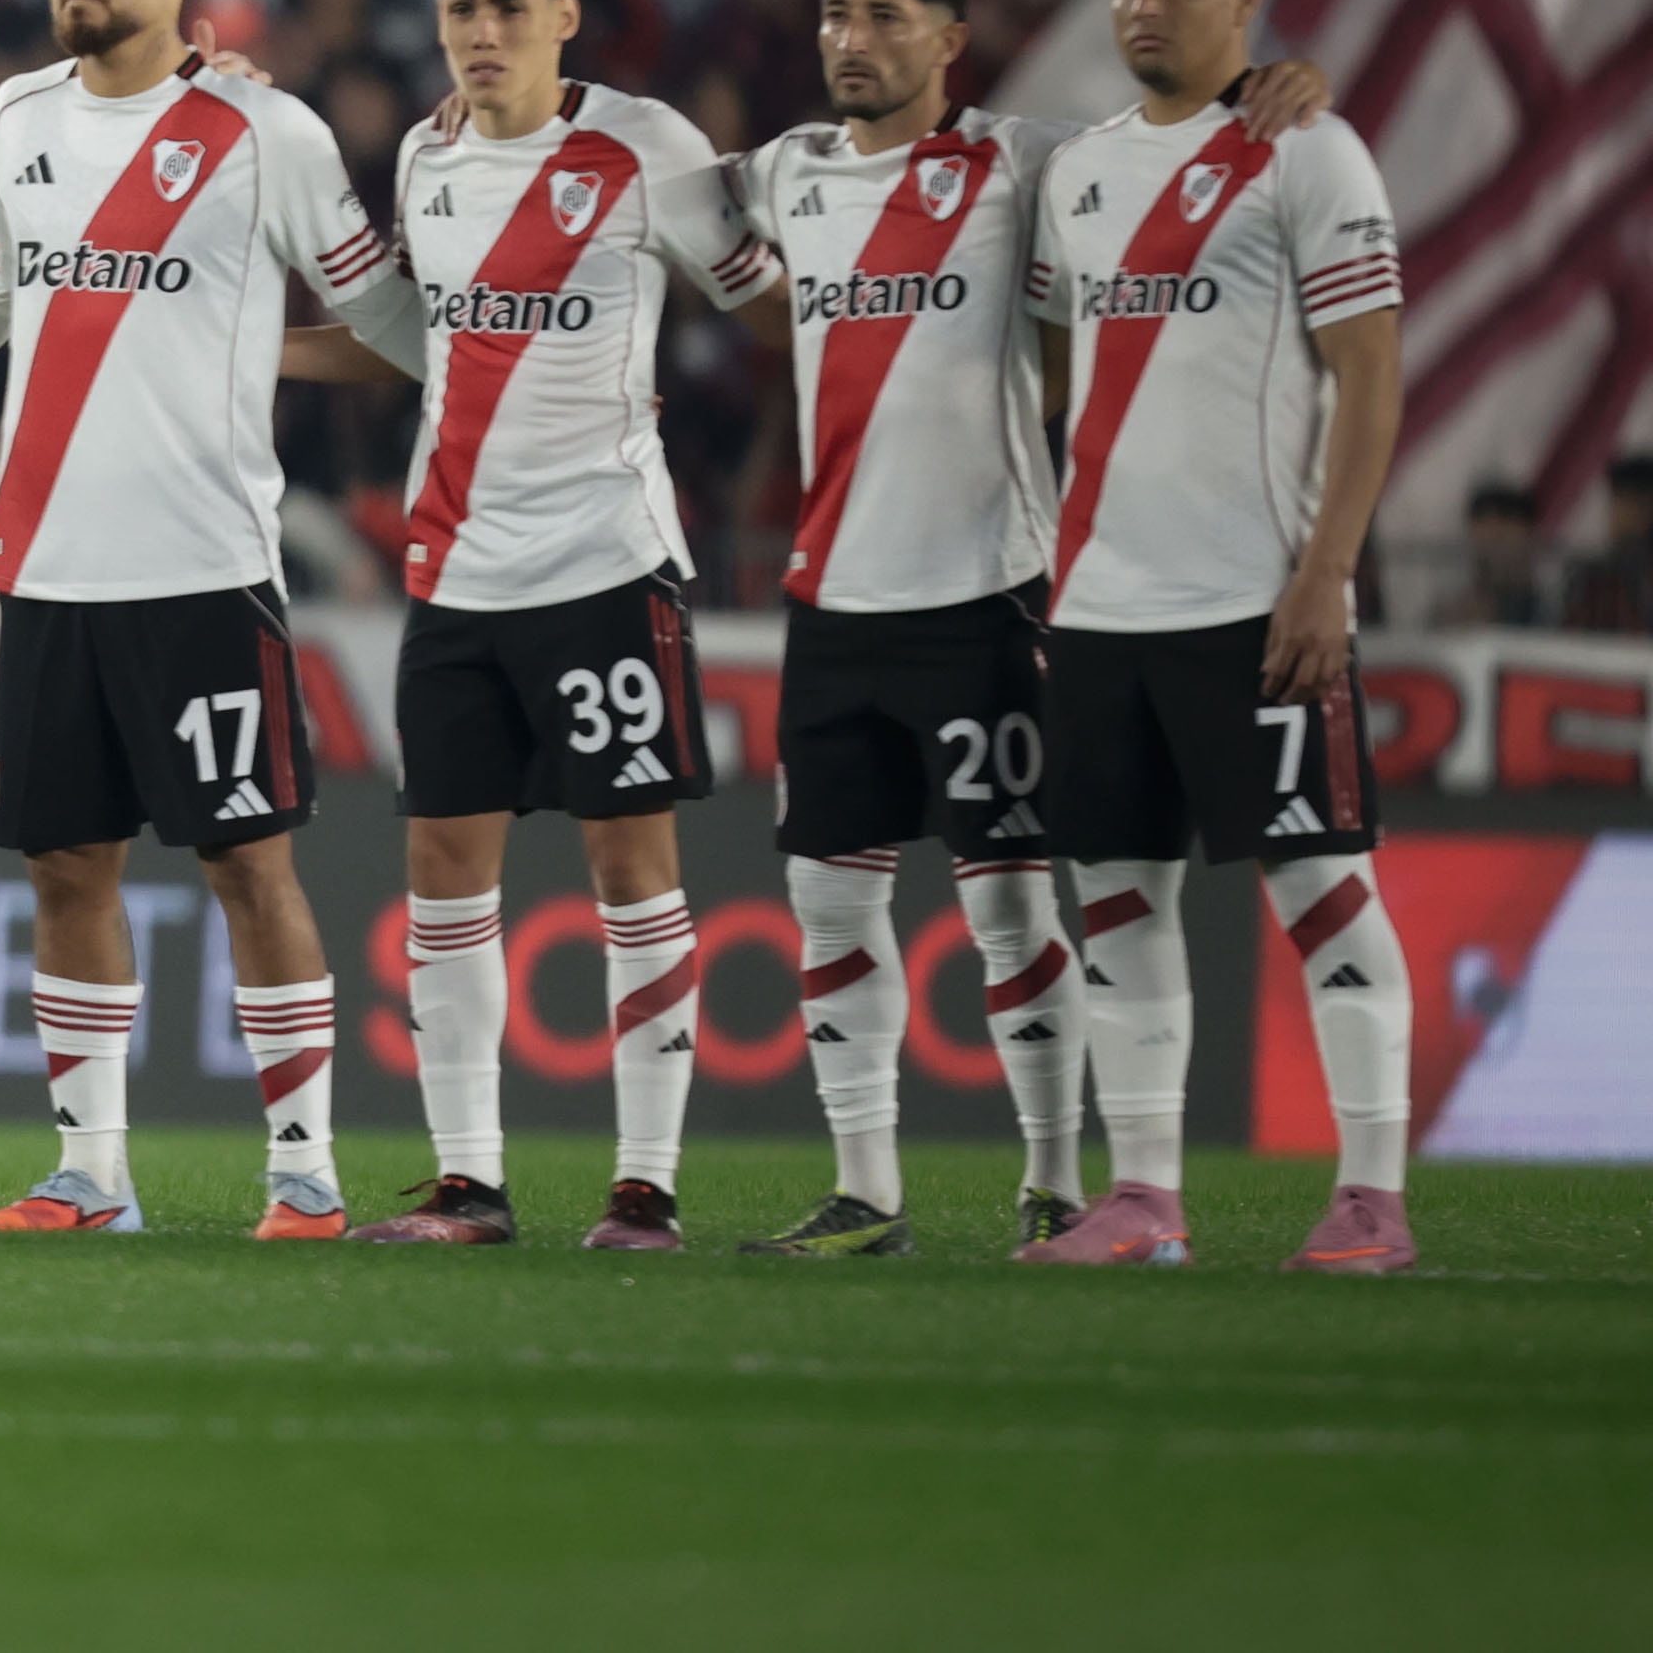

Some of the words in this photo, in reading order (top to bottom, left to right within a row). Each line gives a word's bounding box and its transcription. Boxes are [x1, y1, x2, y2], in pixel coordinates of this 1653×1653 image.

[18, 241, 191, 294] Betano
[797, 269, 966, 325] Betano
[174, 688, 262, 783] 17
[556, 656, 665, 754] 39
[1256, 705, 1307, 794] 7
[937, 711, 1045, 802] 20
